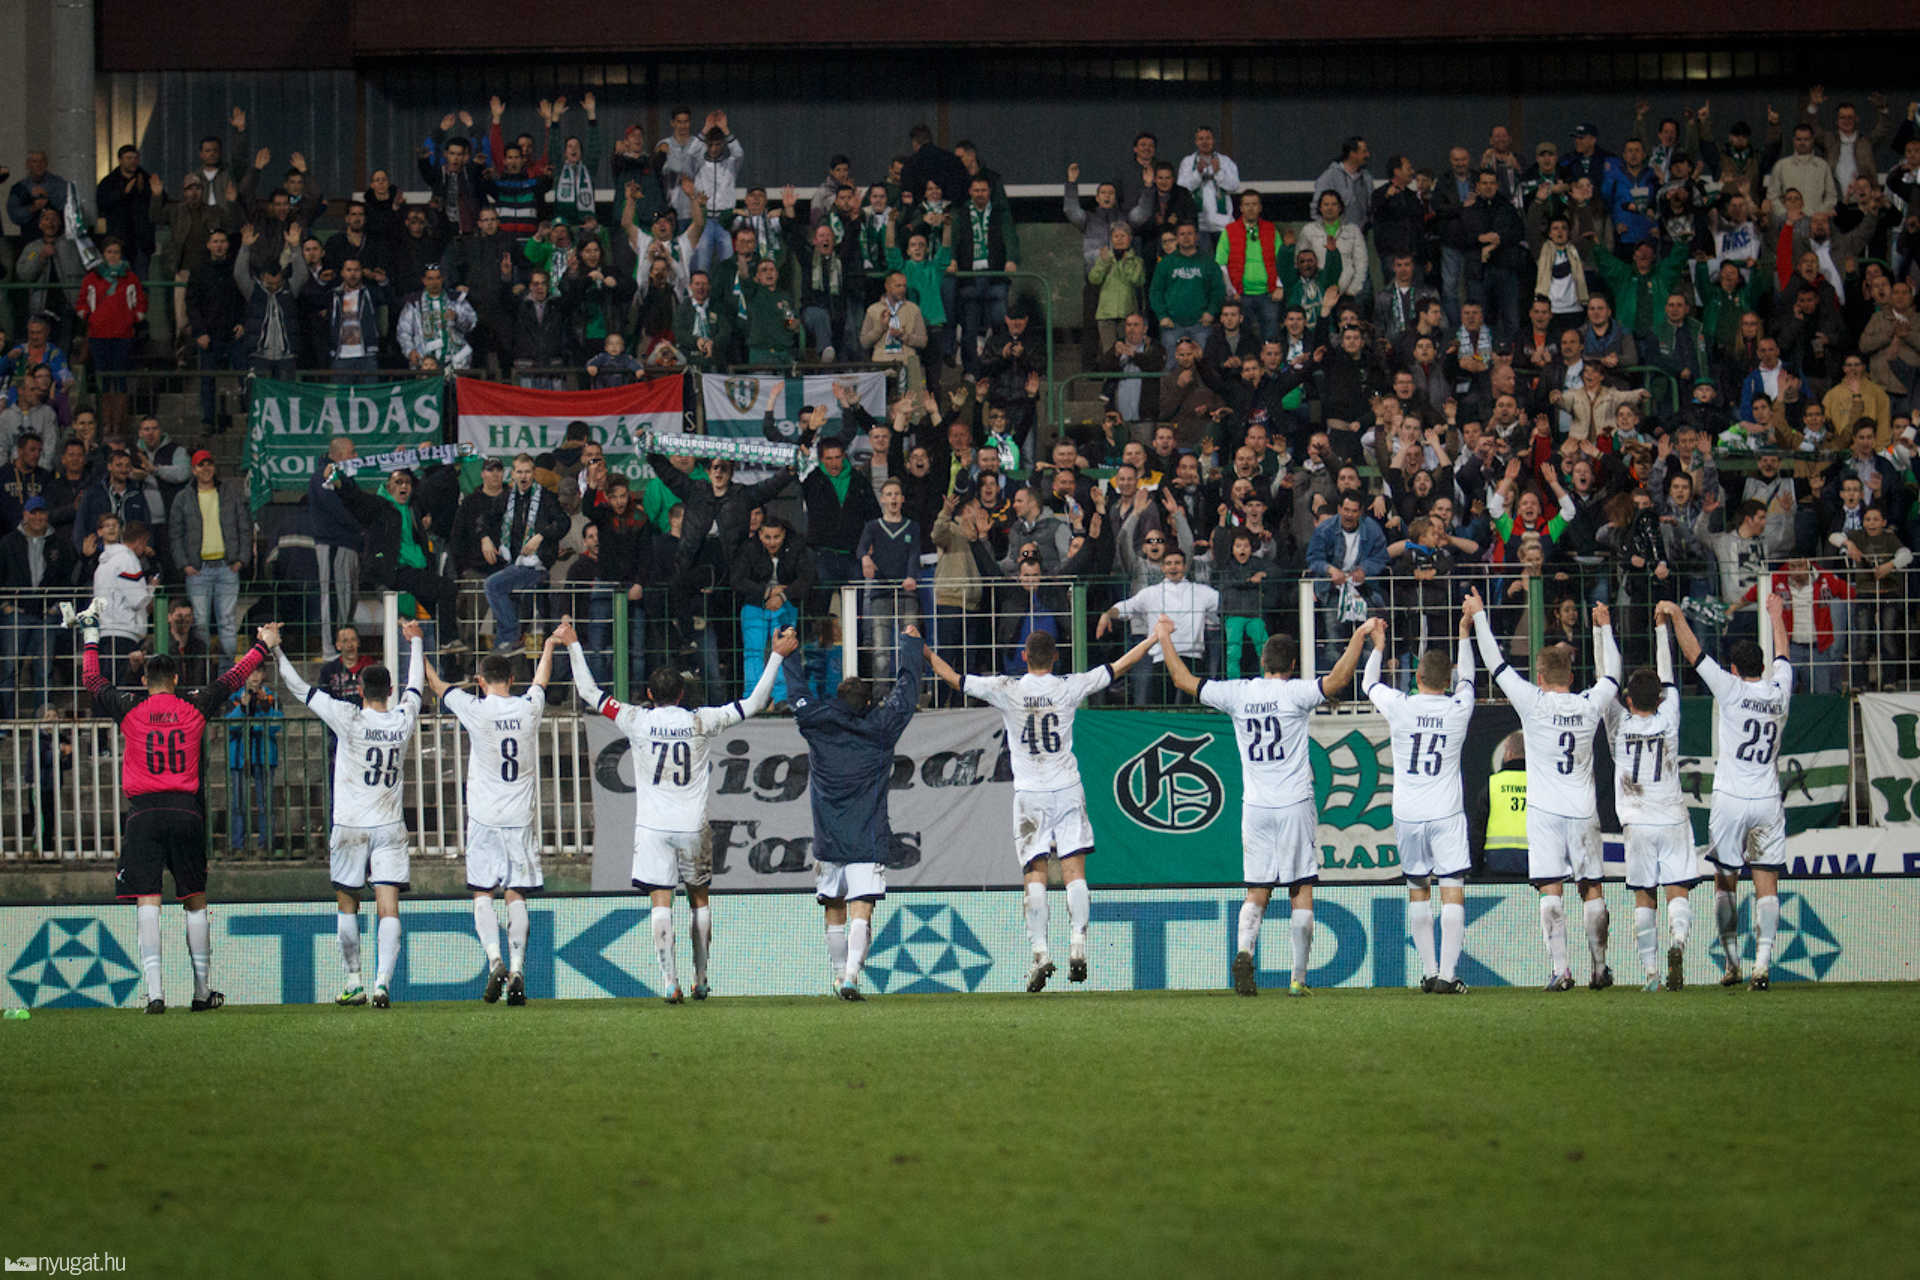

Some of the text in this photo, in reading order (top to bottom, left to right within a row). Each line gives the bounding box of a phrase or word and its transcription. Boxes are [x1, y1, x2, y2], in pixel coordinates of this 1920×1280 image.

[146, 729, 186, 775] 66
[1021, 712, 1061, 755] 46
[1246, 715, 1285, 762] 22
[1407, 732, 1447, 777] 15
[1556, 731, 1576, 775] 3
[1736, 718, 1777, 765] 23
[364, 747, 400, 789] 35
[501, 737, 519, 783] 8
[651, 740, 691, 787] 79
[1625, 737, 1664, 784] 77
[227, 907, 660, 1005] TDK
[1088, 895, 1516, 990] TDK
